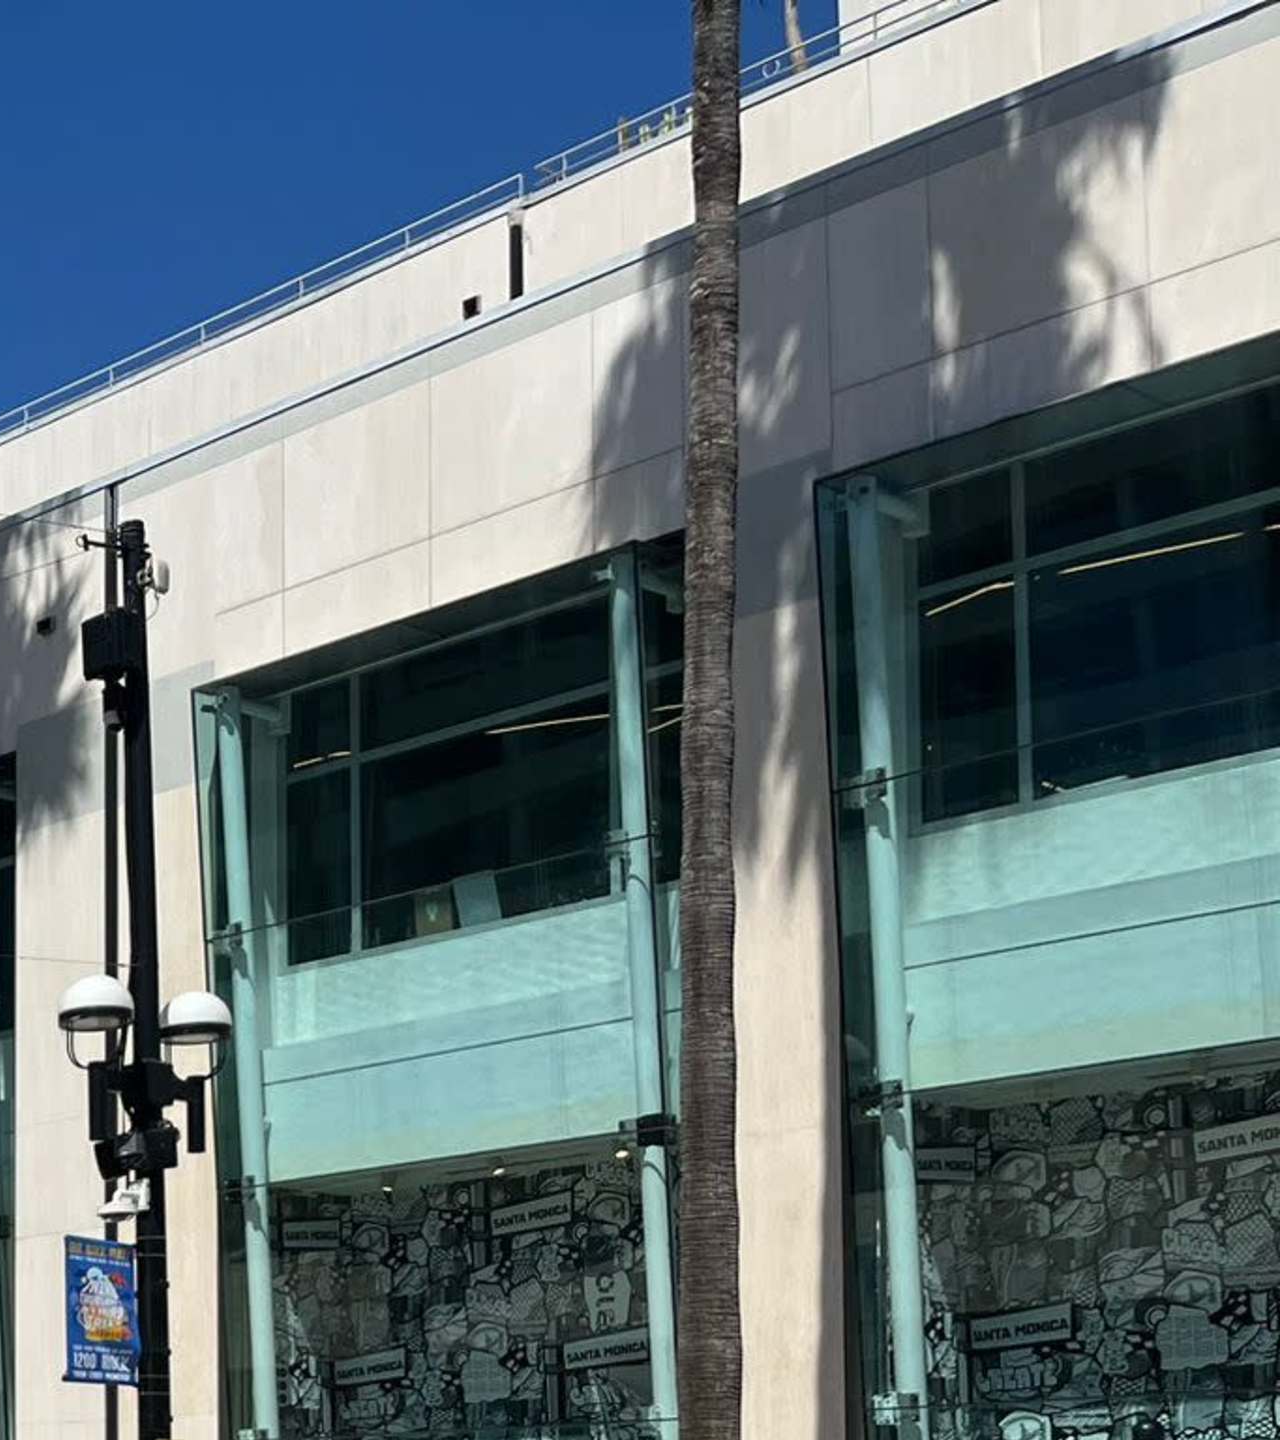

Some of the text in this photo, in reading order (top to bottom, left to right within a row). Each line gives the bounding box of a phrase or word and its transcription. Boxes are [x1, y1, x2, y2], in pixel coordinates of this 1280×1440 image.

[1198, 1133, 1247, 1153] SANTA
[494, 1203, 568, 1229] SANTA MONICA
[1015, 1317, 1068, 1336] MONICA
[567, 1341, 646, 1363] SANTA MONICA
